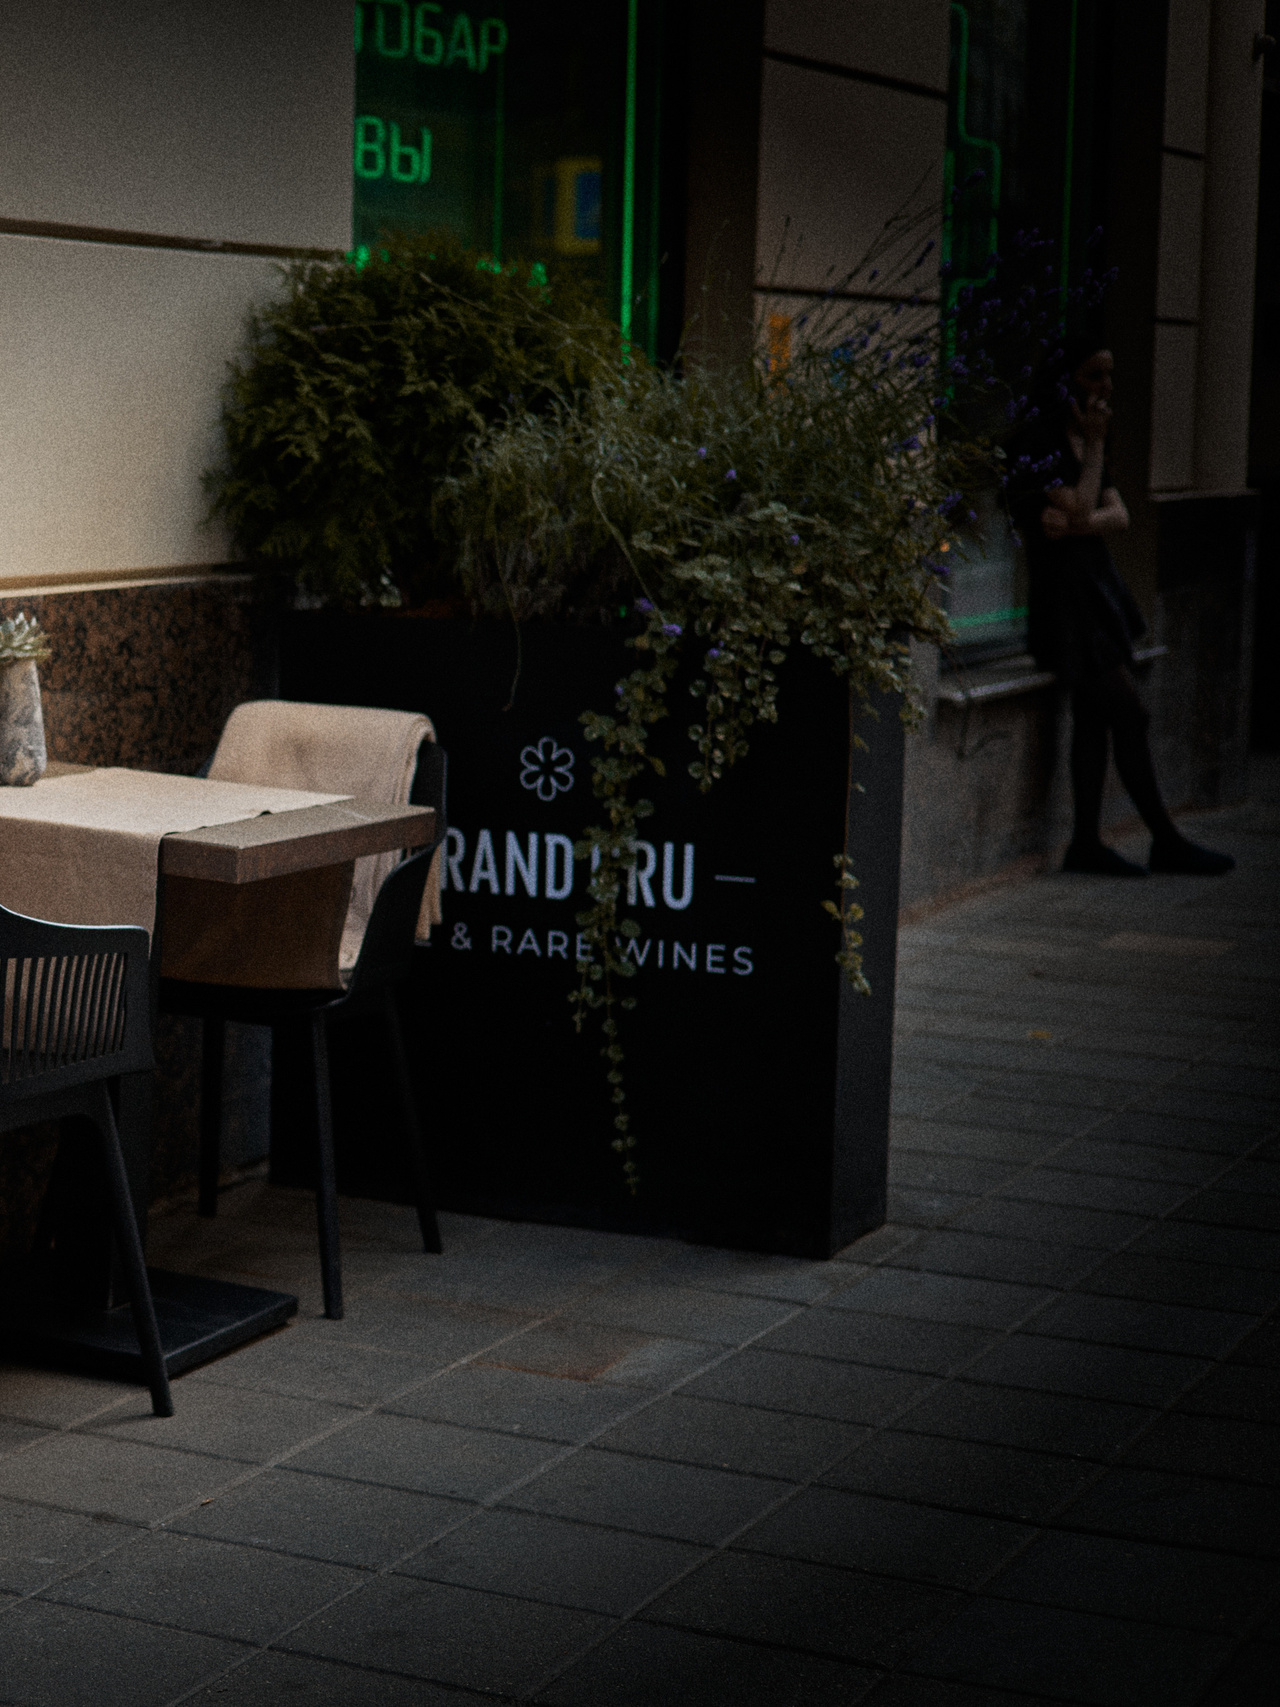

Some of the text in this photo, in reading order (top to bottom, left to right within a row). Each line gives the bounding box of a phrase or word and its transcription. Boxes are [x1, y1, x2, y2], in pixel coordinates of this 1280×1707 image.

[440, 826, 574, 901] RAND
[450, 922, 755, 976] & RARE WINES
